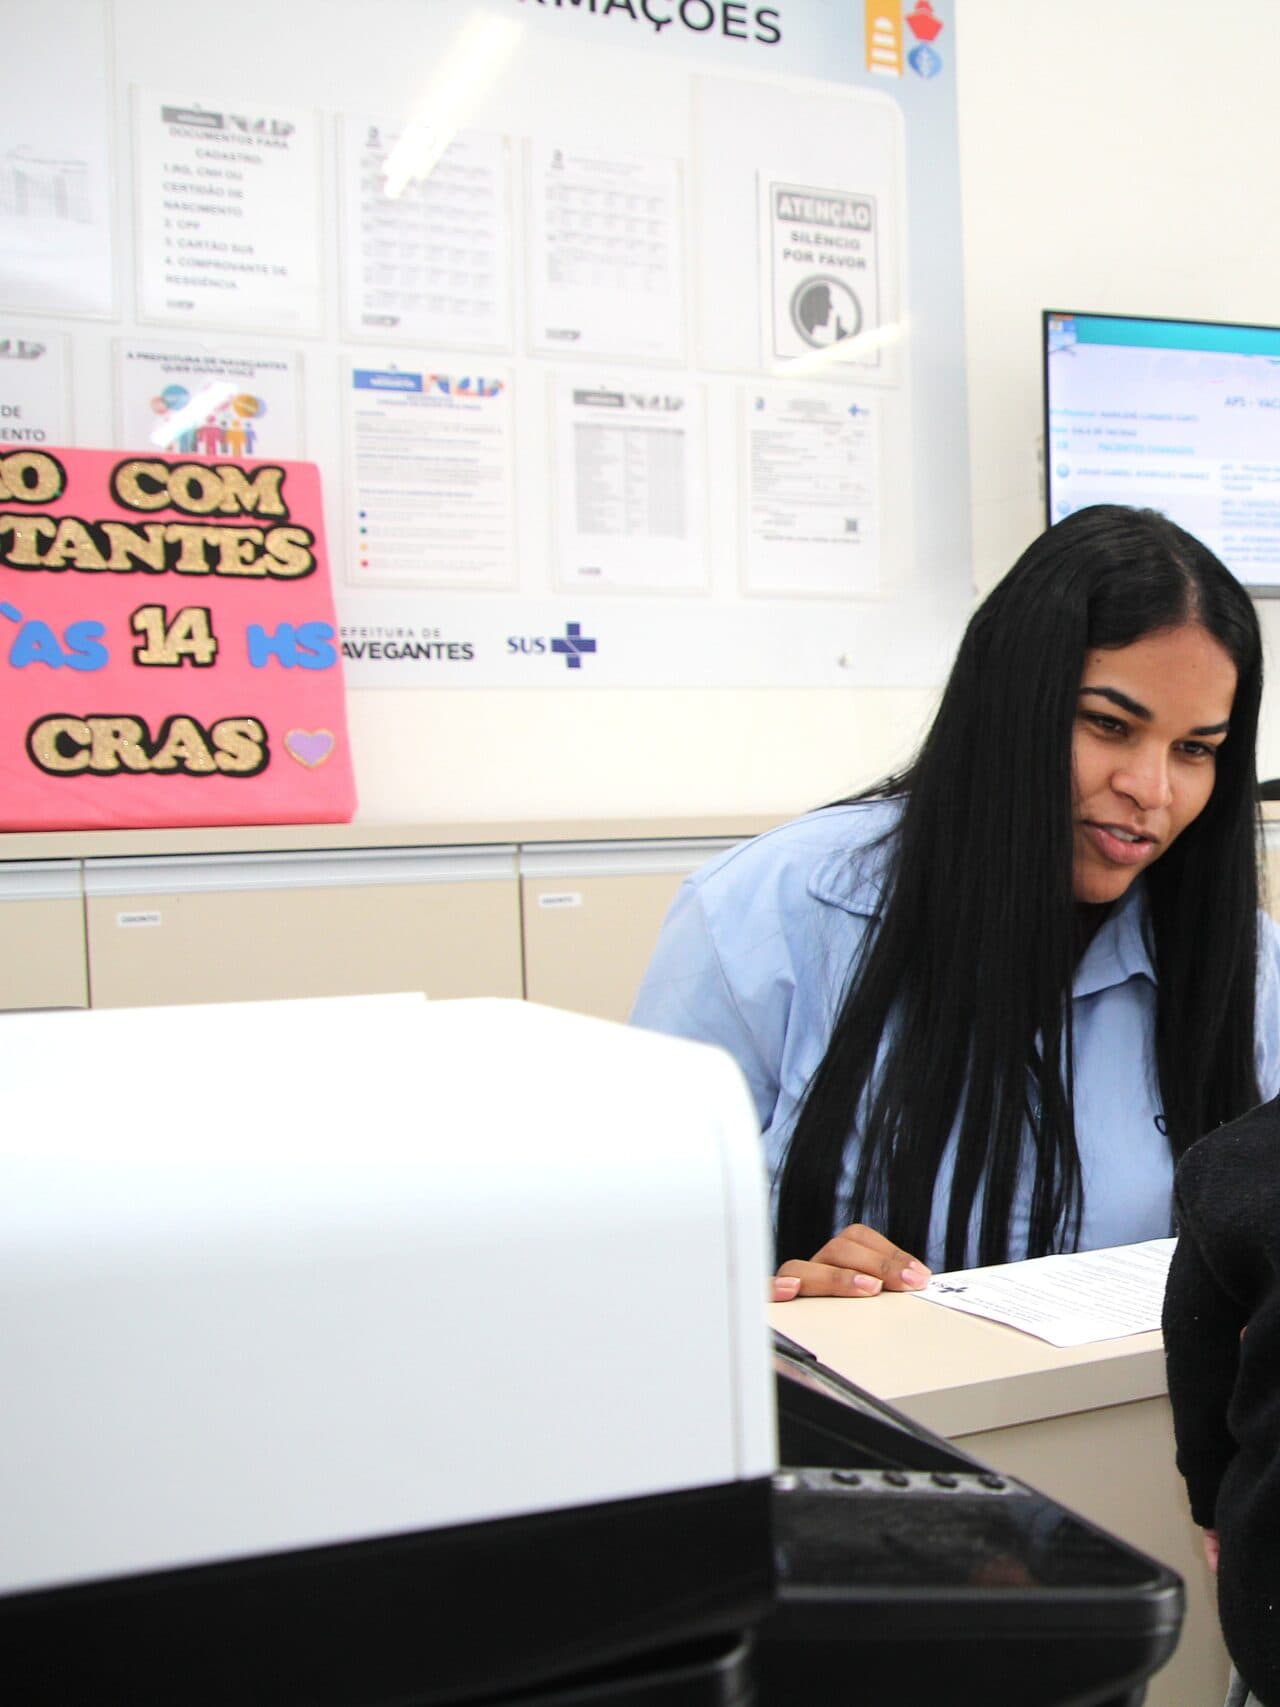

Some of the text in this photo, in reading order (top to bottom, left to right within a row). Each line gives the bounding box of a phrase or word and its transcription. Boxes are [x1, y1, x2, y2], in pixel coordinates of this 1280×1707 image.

[163, 200, 243, 217] NASCIMENTO
[783, 247, 867, 270] POR FAVOR
[110, 458, 290, 521] COM
[129, 604, 217, 667] 14
[246, 621, 337, 671] HS
[422, 628, 441, 638] DE
[506, 636, 546, 654] SUS
[26, 713, 270, 778] CRAS
